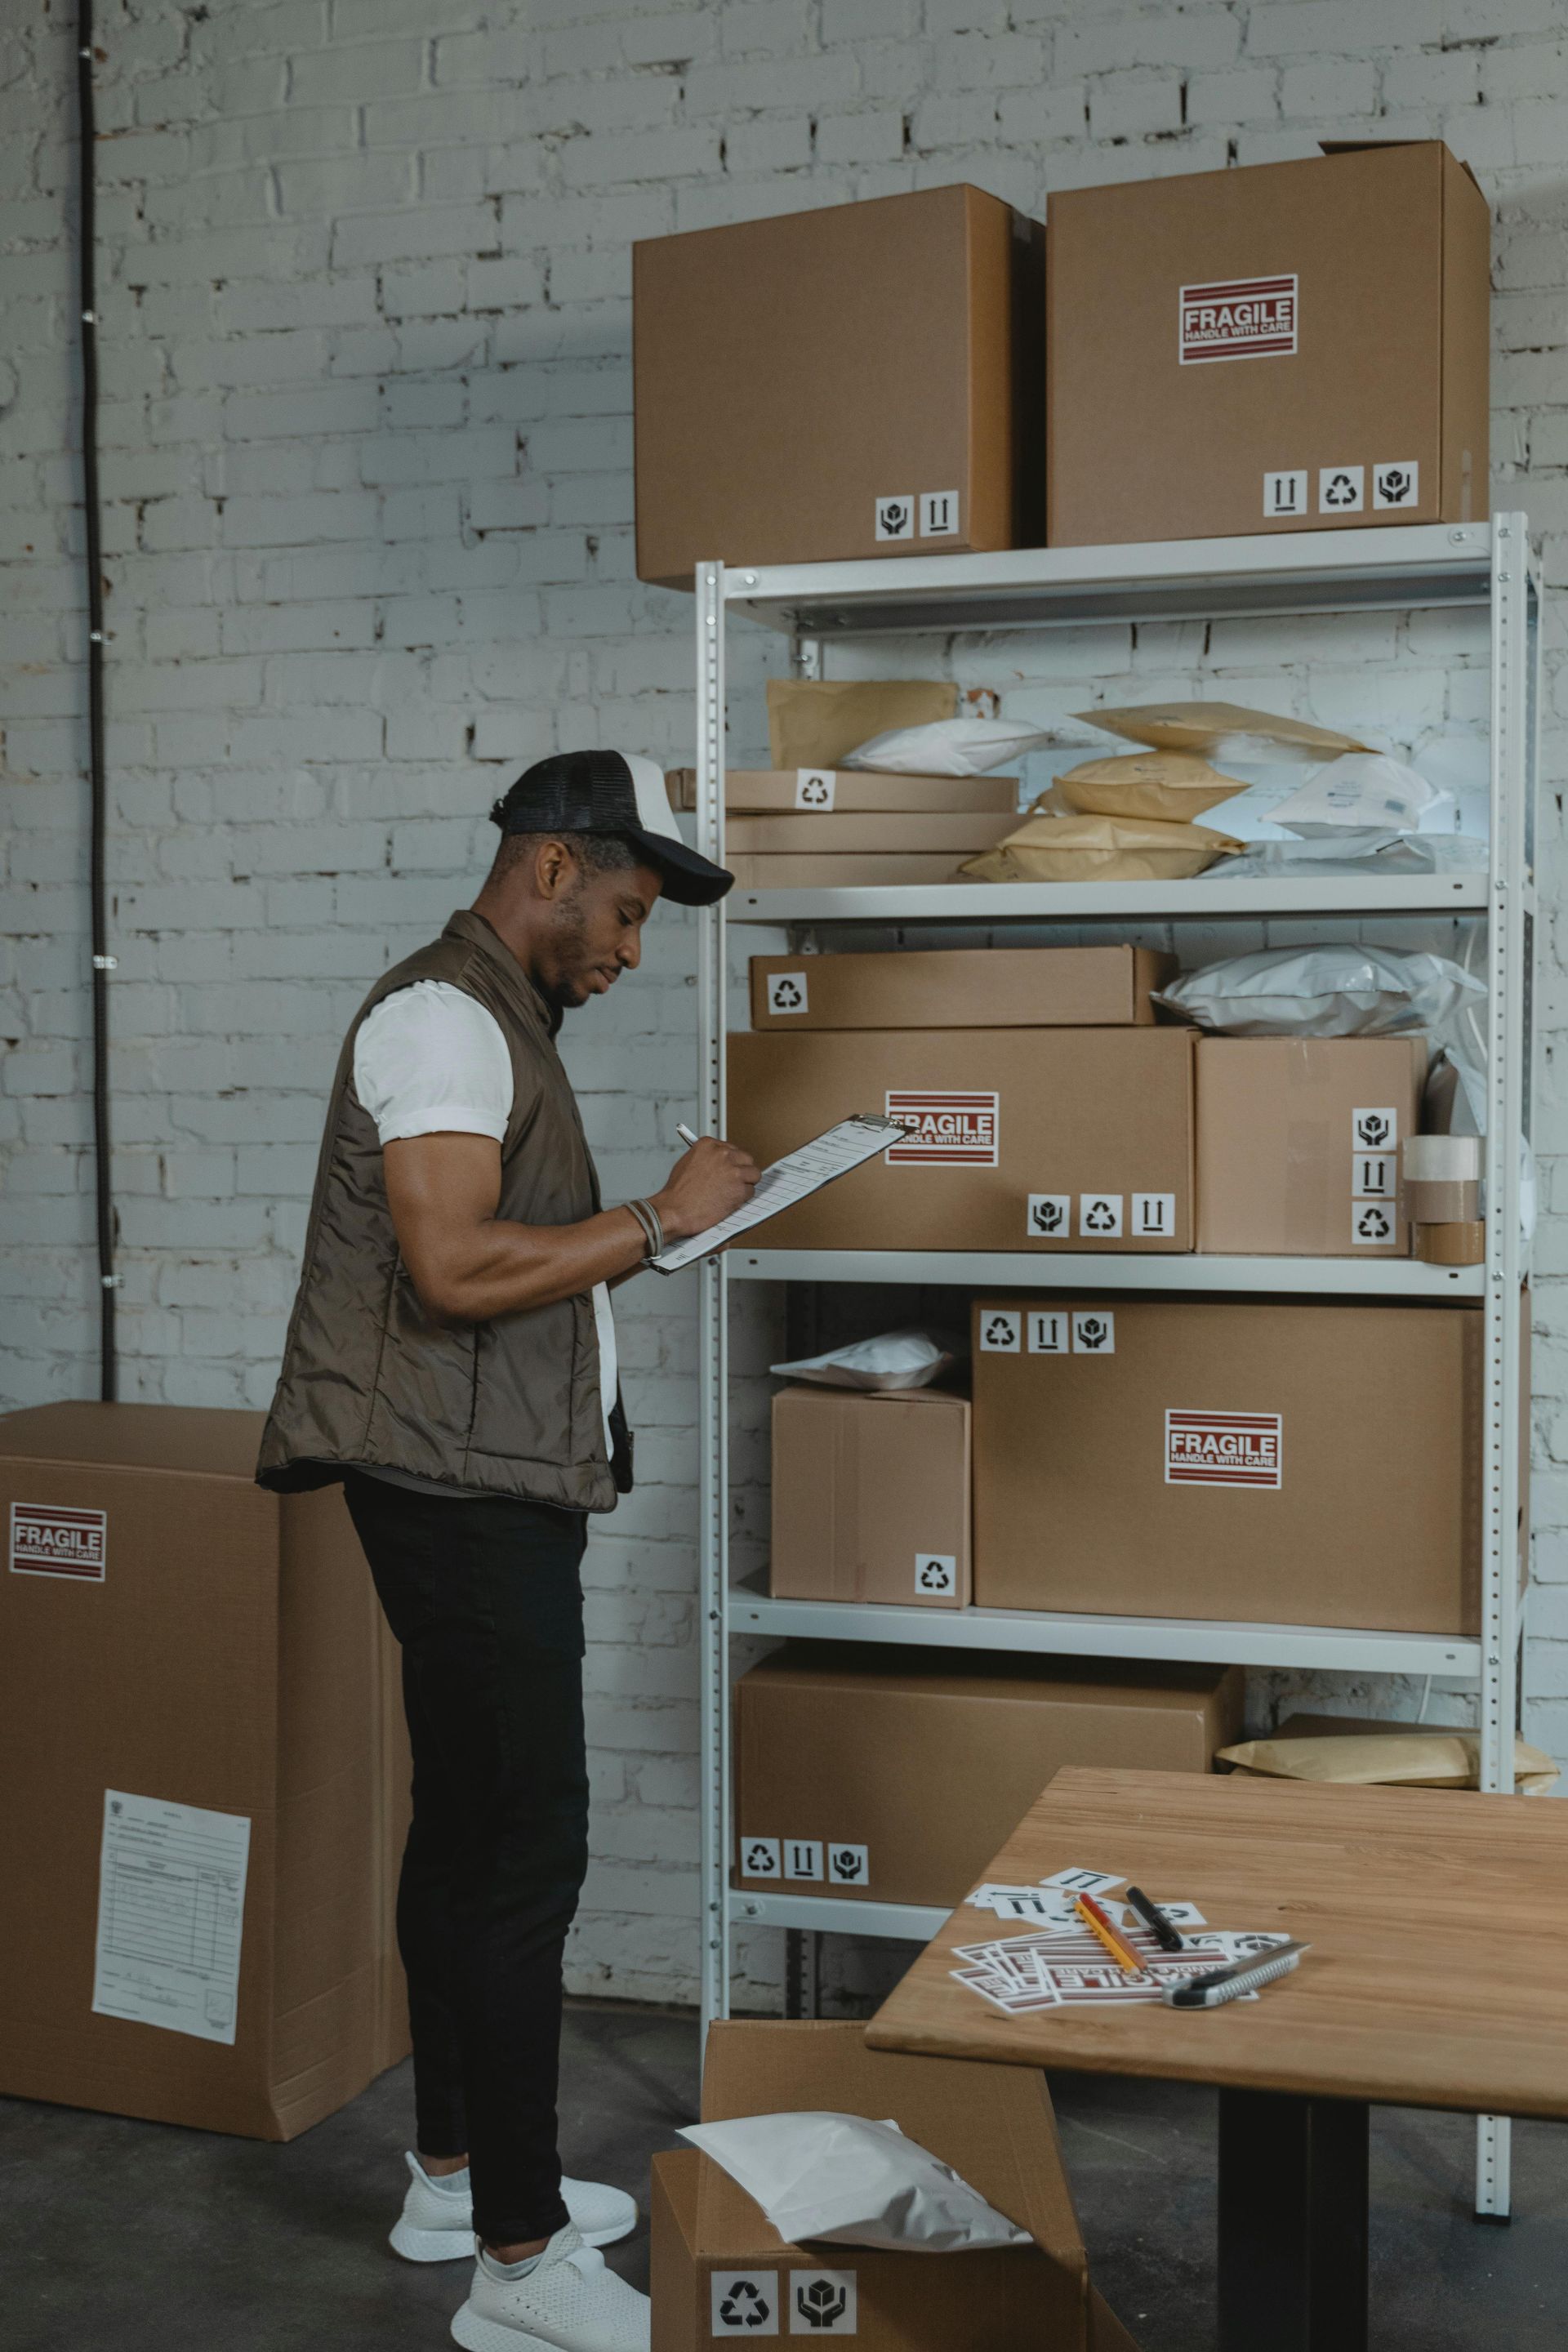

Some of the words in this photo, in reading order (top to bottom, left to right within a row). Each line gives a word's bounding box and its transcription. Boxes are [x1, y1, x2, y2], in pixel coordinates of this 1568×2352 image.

[1184, 300, 1292, 332] FRAGILE
[1185, 327, 1228, 341] HANDLE
[1231, 325, 1258, 336] WITH
[1260, 322, 1291, 333] CARE
[899, 1134, 933, 1144] ANDLE
[934, 1134, 961, 1144] WITH
[962, 1135, 993, 1145] CARE
[1170, 1432, 1276, 1457] FRAGILE
[1170, 1452, 1215, 1463] HANDLE
[1215, 1454, 1244, 1465] WITH
[1245, 1456, 1276, 1468] CARE
[16, 1525, 101, 1551] FRAGILE
[16, 1544, 50, 1555] HANDLE
[52, 1547, 75, 1557] WITH
[77, 1549, 101, 1561] CARE
